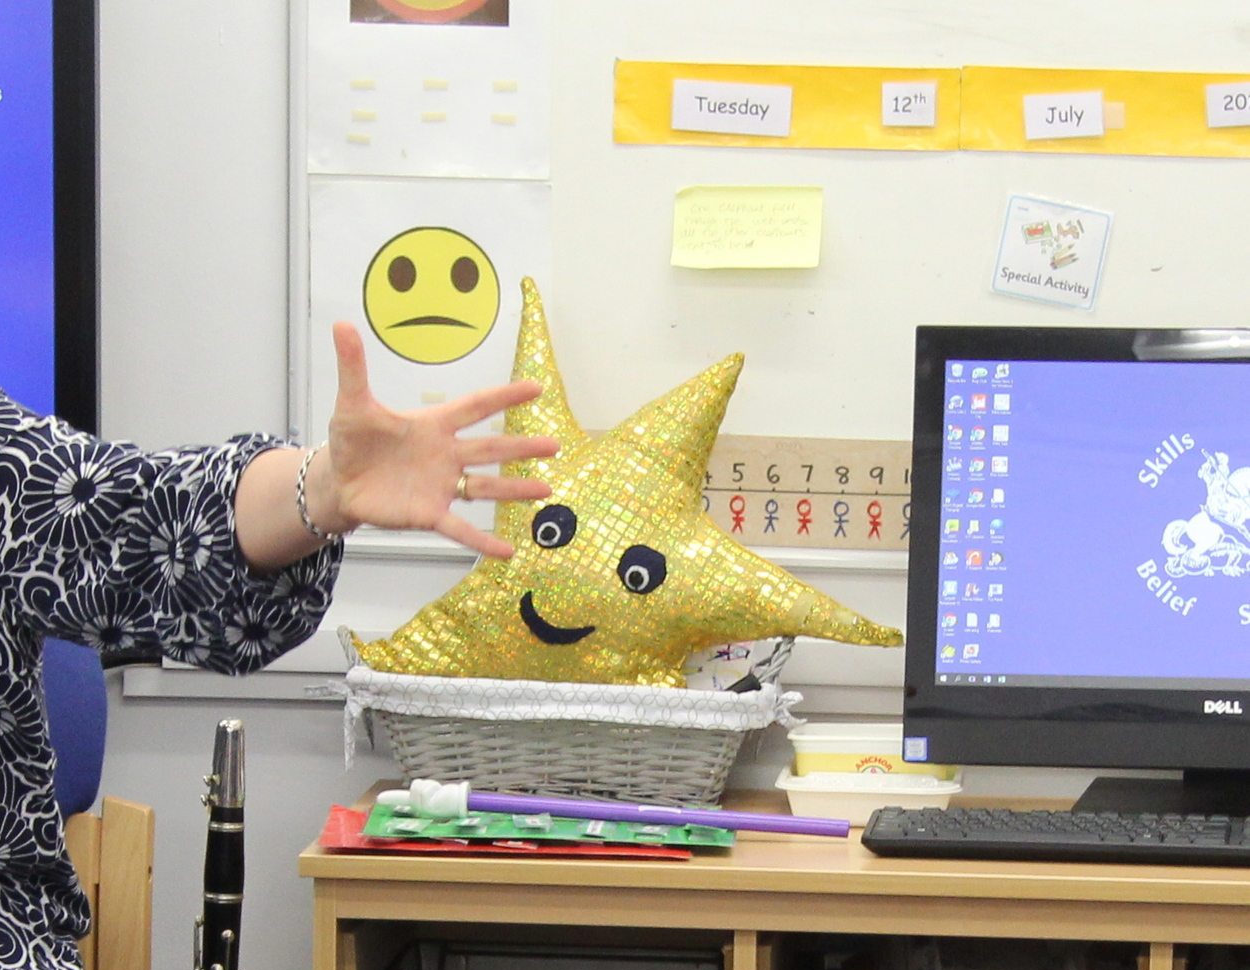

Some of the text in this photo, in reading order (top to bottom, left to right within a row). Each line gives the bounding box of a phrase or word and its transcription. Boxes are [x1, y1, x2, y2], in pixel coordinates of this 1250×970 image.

[694, 92, 1250, 128] Tuesday 12th July 20
[1000, 266, 1090, 299] Special Activity
[732, 462, 746, 482] 5
[766, 464, 781, 484] 6
[801, 464, 814, 482] 7
[835, 466, 850, 485] 8
[869, 466, 884, 485] 9
[1138, 432, 1196, 489] Skills
[1136, 558, 1198, 617] Belief
[1204, 699, 1243, 715] DELL
[855, 755, 893, 773] ANCHOR
